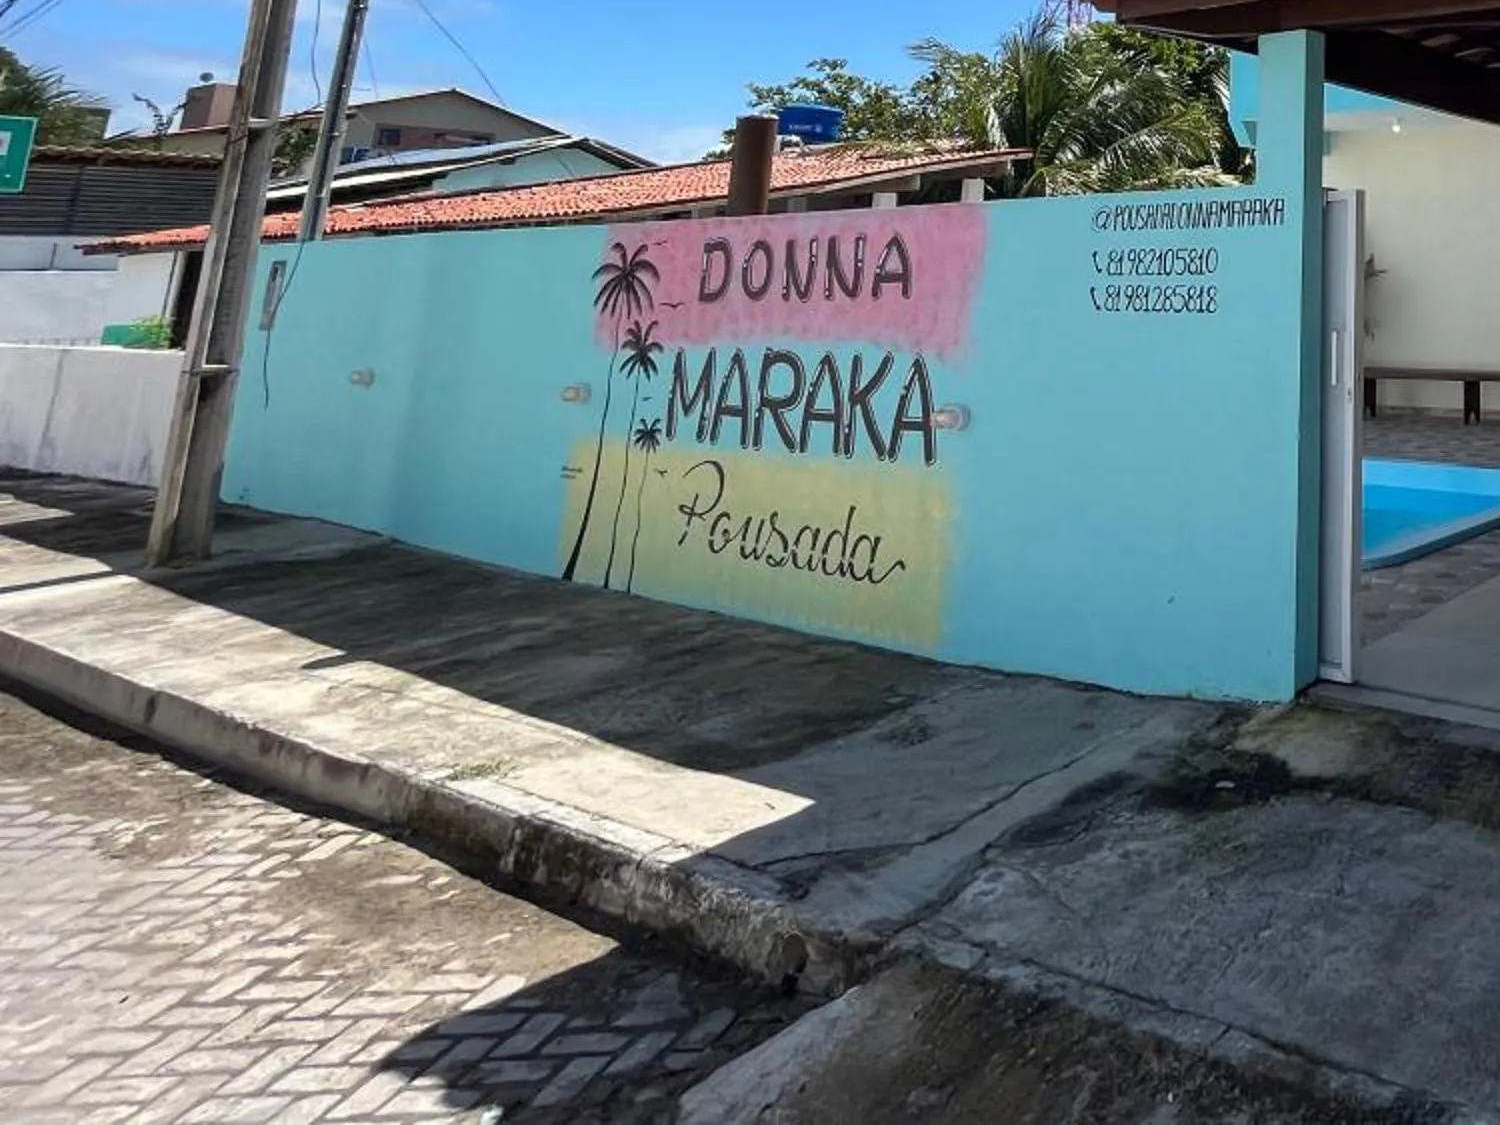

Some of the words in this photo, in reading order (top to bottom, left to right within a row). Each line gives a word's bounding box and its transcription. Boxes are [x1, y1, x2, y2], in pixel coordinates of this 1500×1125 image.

[697, 234, 913, 303] DONNA
[664, 345, 937, 467] MARAKA
[677, 459, 907, 585] Pousada
